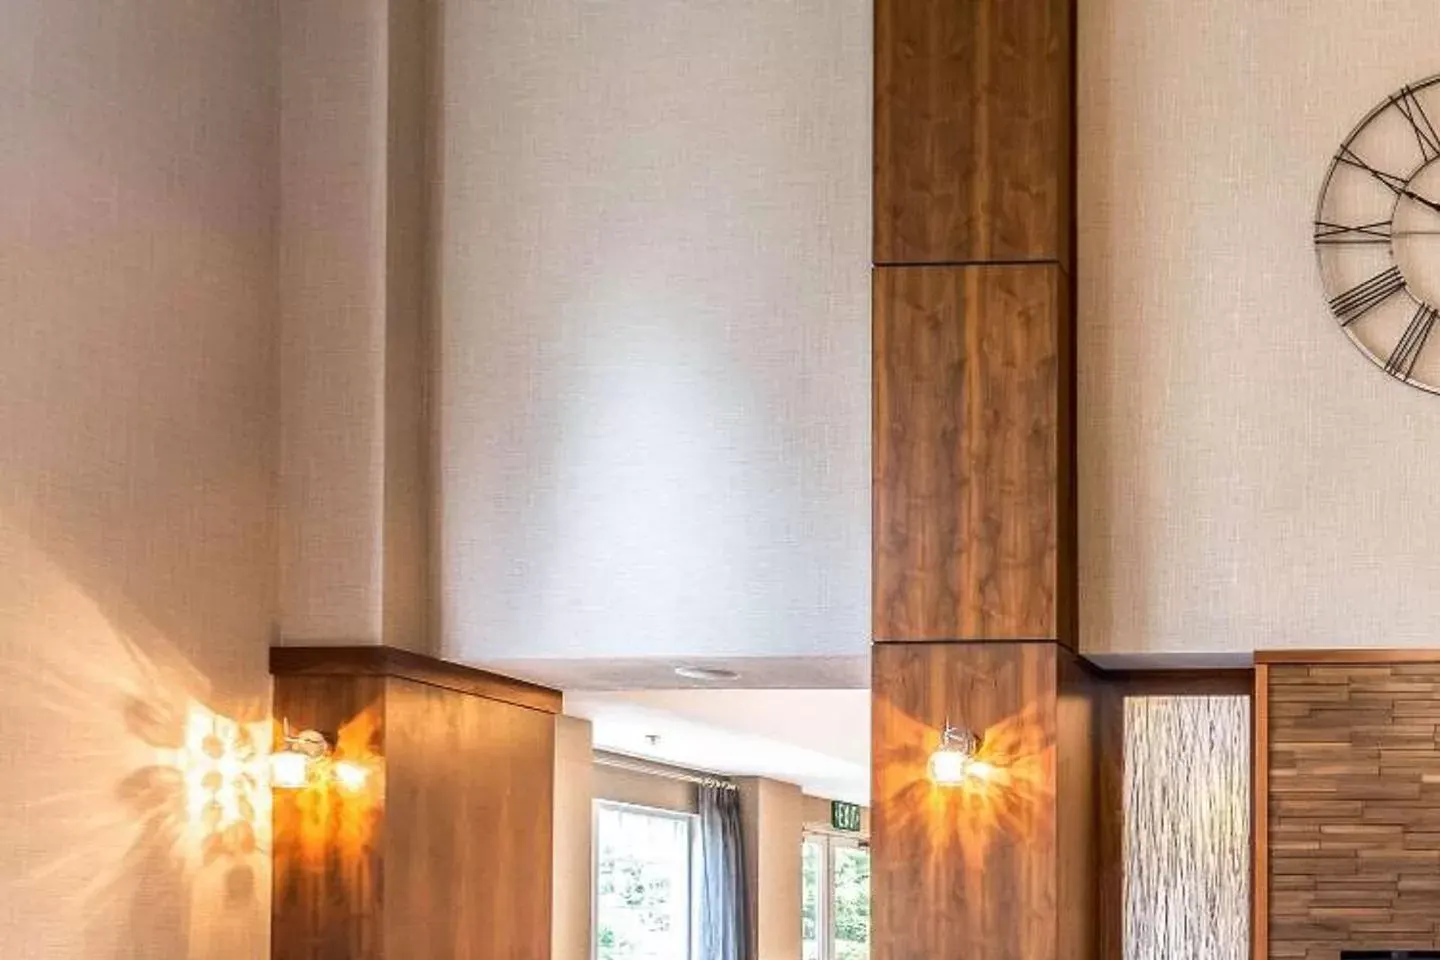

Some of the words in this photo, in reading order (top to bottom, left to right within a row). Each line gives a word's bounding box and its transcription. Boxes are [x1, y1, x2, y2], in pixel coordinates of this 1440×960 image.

[1333, 143, 1410, 195] X
[1314, 220, 1393, 244] IX
[1328, 264, 1407, 327] VIII
[1384, 301, 1440, 382] VII
